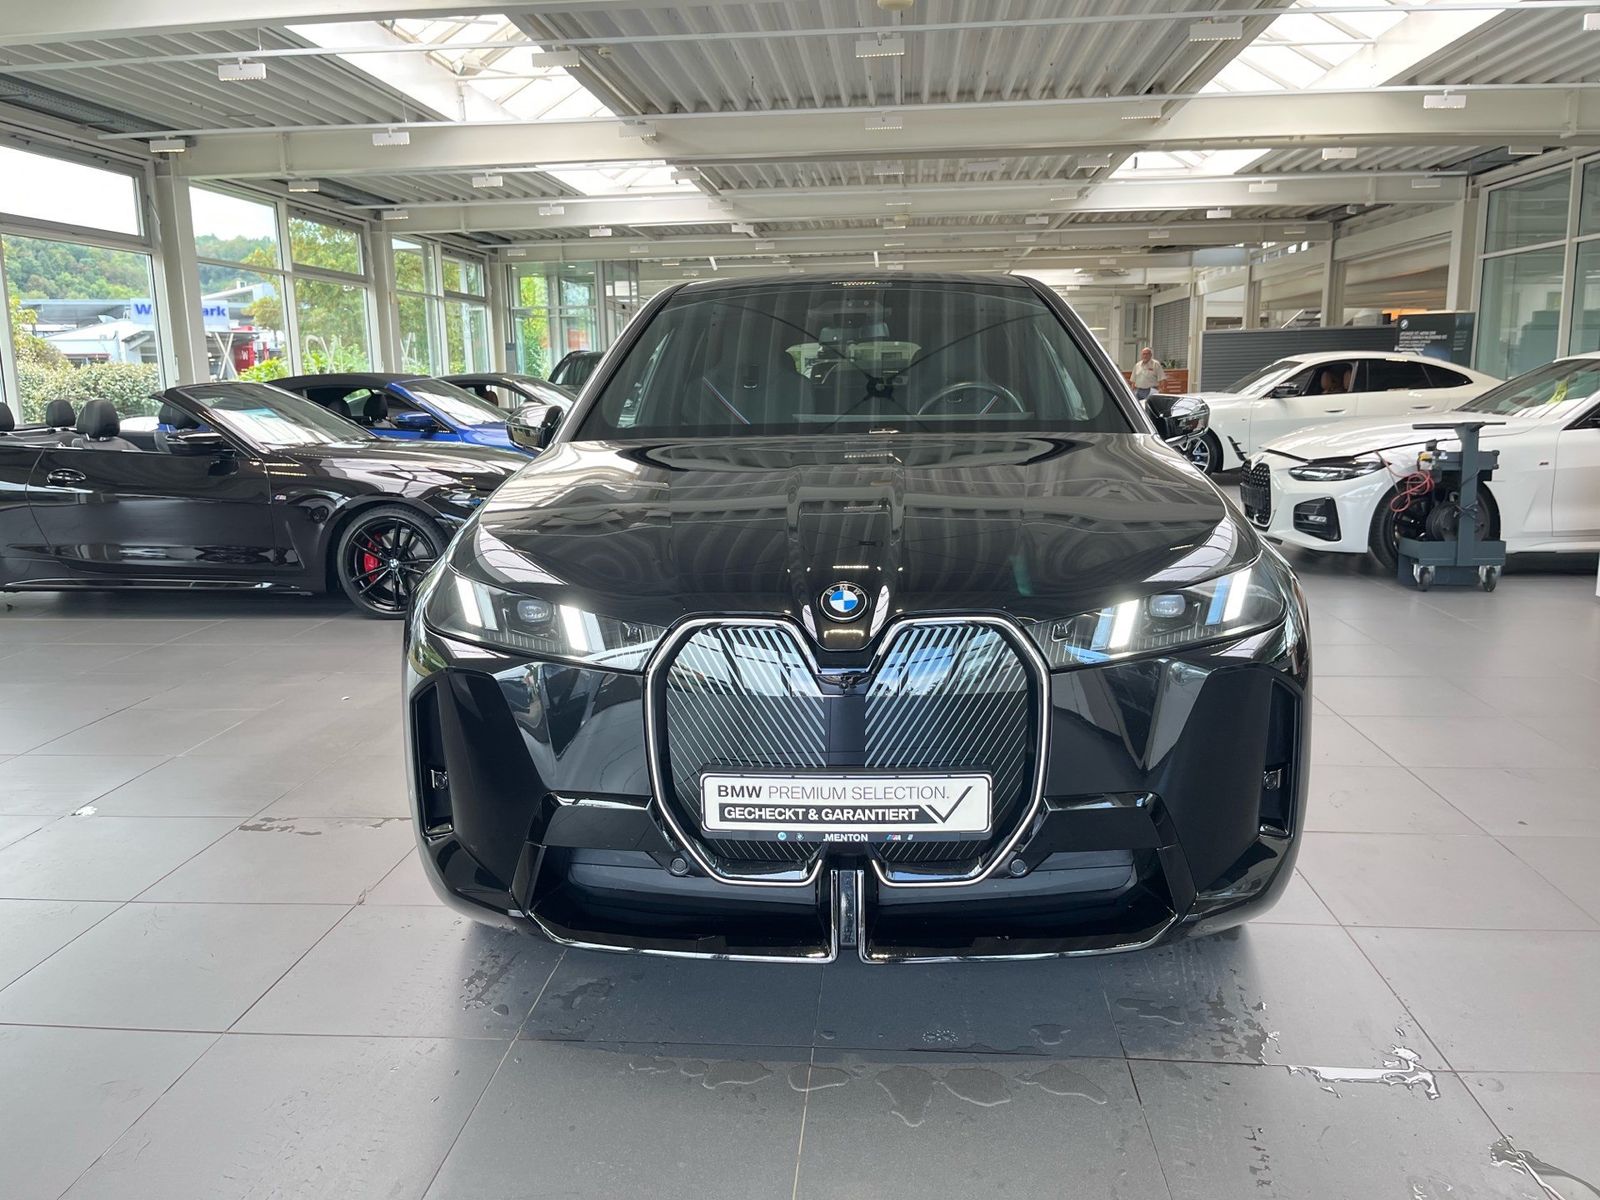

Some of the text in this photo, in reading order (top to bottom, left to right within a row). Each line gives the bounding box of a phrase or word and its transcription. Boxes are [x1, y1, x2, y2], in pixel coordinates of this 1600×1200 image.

[826, 584, 862, 596] BMW
[717, 784, 949, 800] BMW PREMIUM SELECTION.
[723, 807, 919, 821] GECHECKT & GARANTIERT
